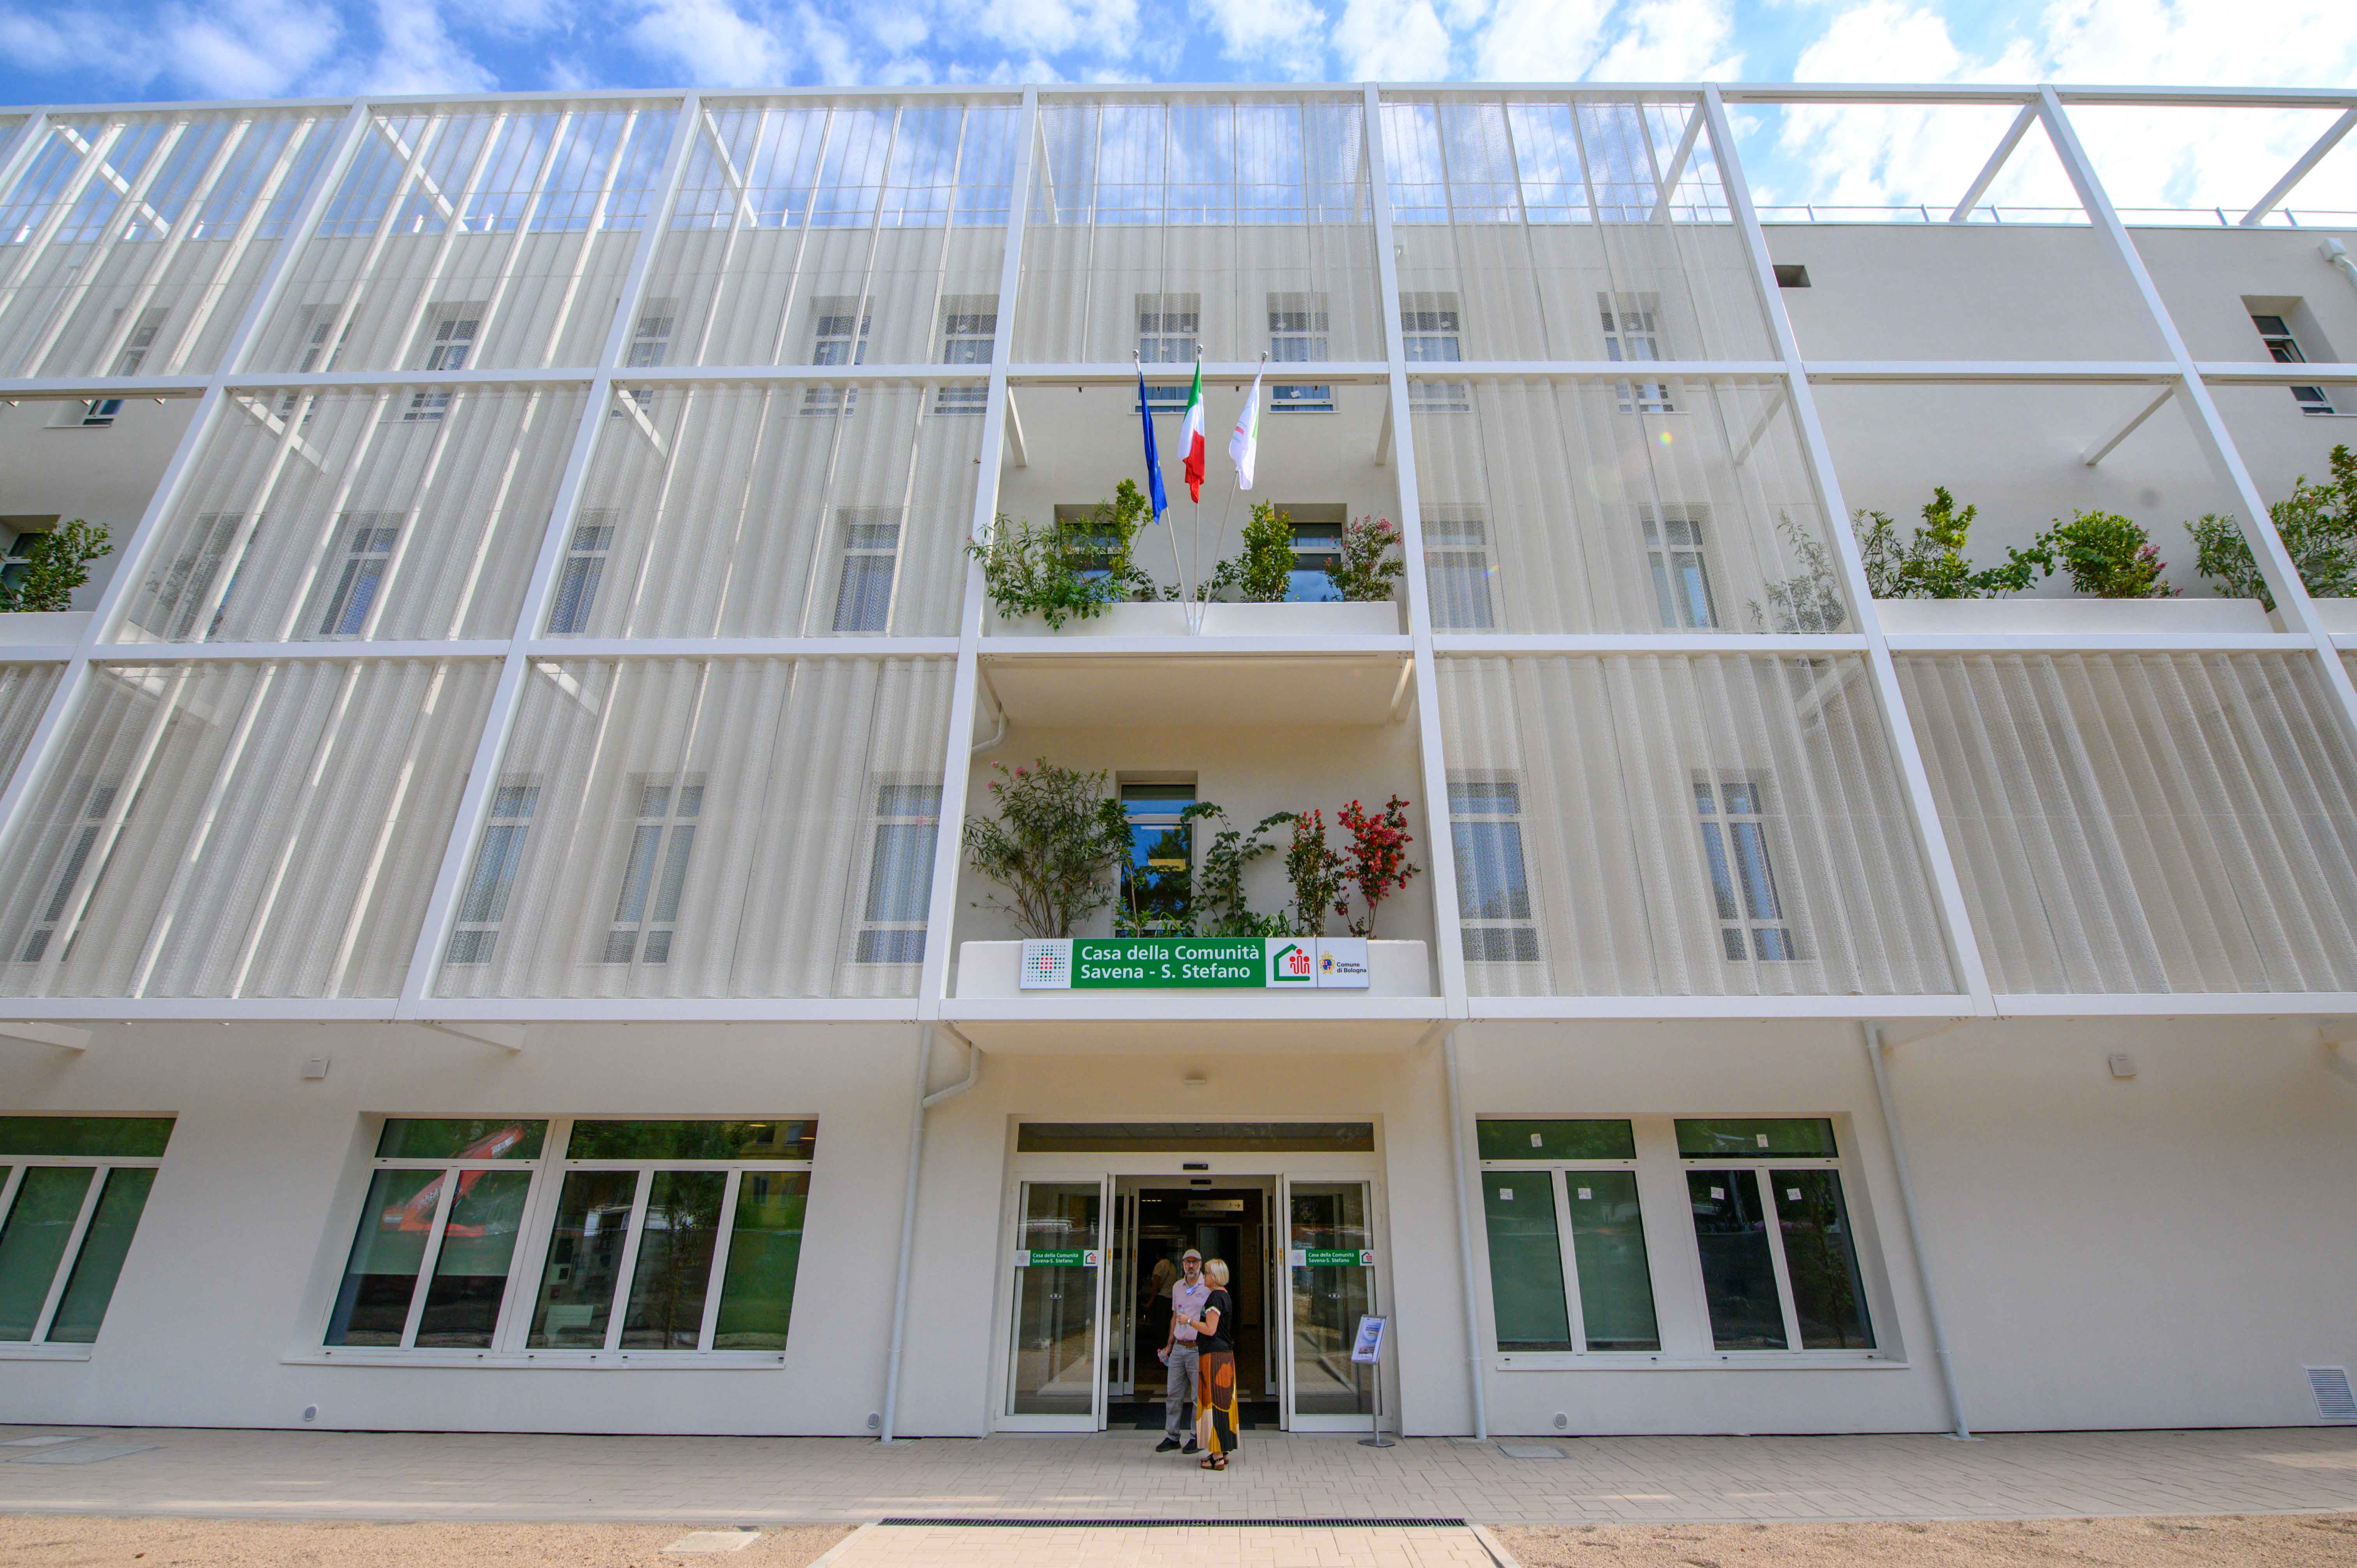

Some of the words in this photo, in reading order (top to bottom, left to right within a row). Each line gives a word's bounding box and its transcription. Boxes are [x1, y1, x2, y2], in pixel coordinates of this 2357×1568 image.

[1082, 946, 1121, 960] Casa
[1127, 945, 1168, 960] della
[1175, 945, 1259, 959] Comunità
[1081, 964, 1143, 978] Savena
[1162, 964, 1175, 978] S.
[1182, 963, 1250, 978] Stefano
